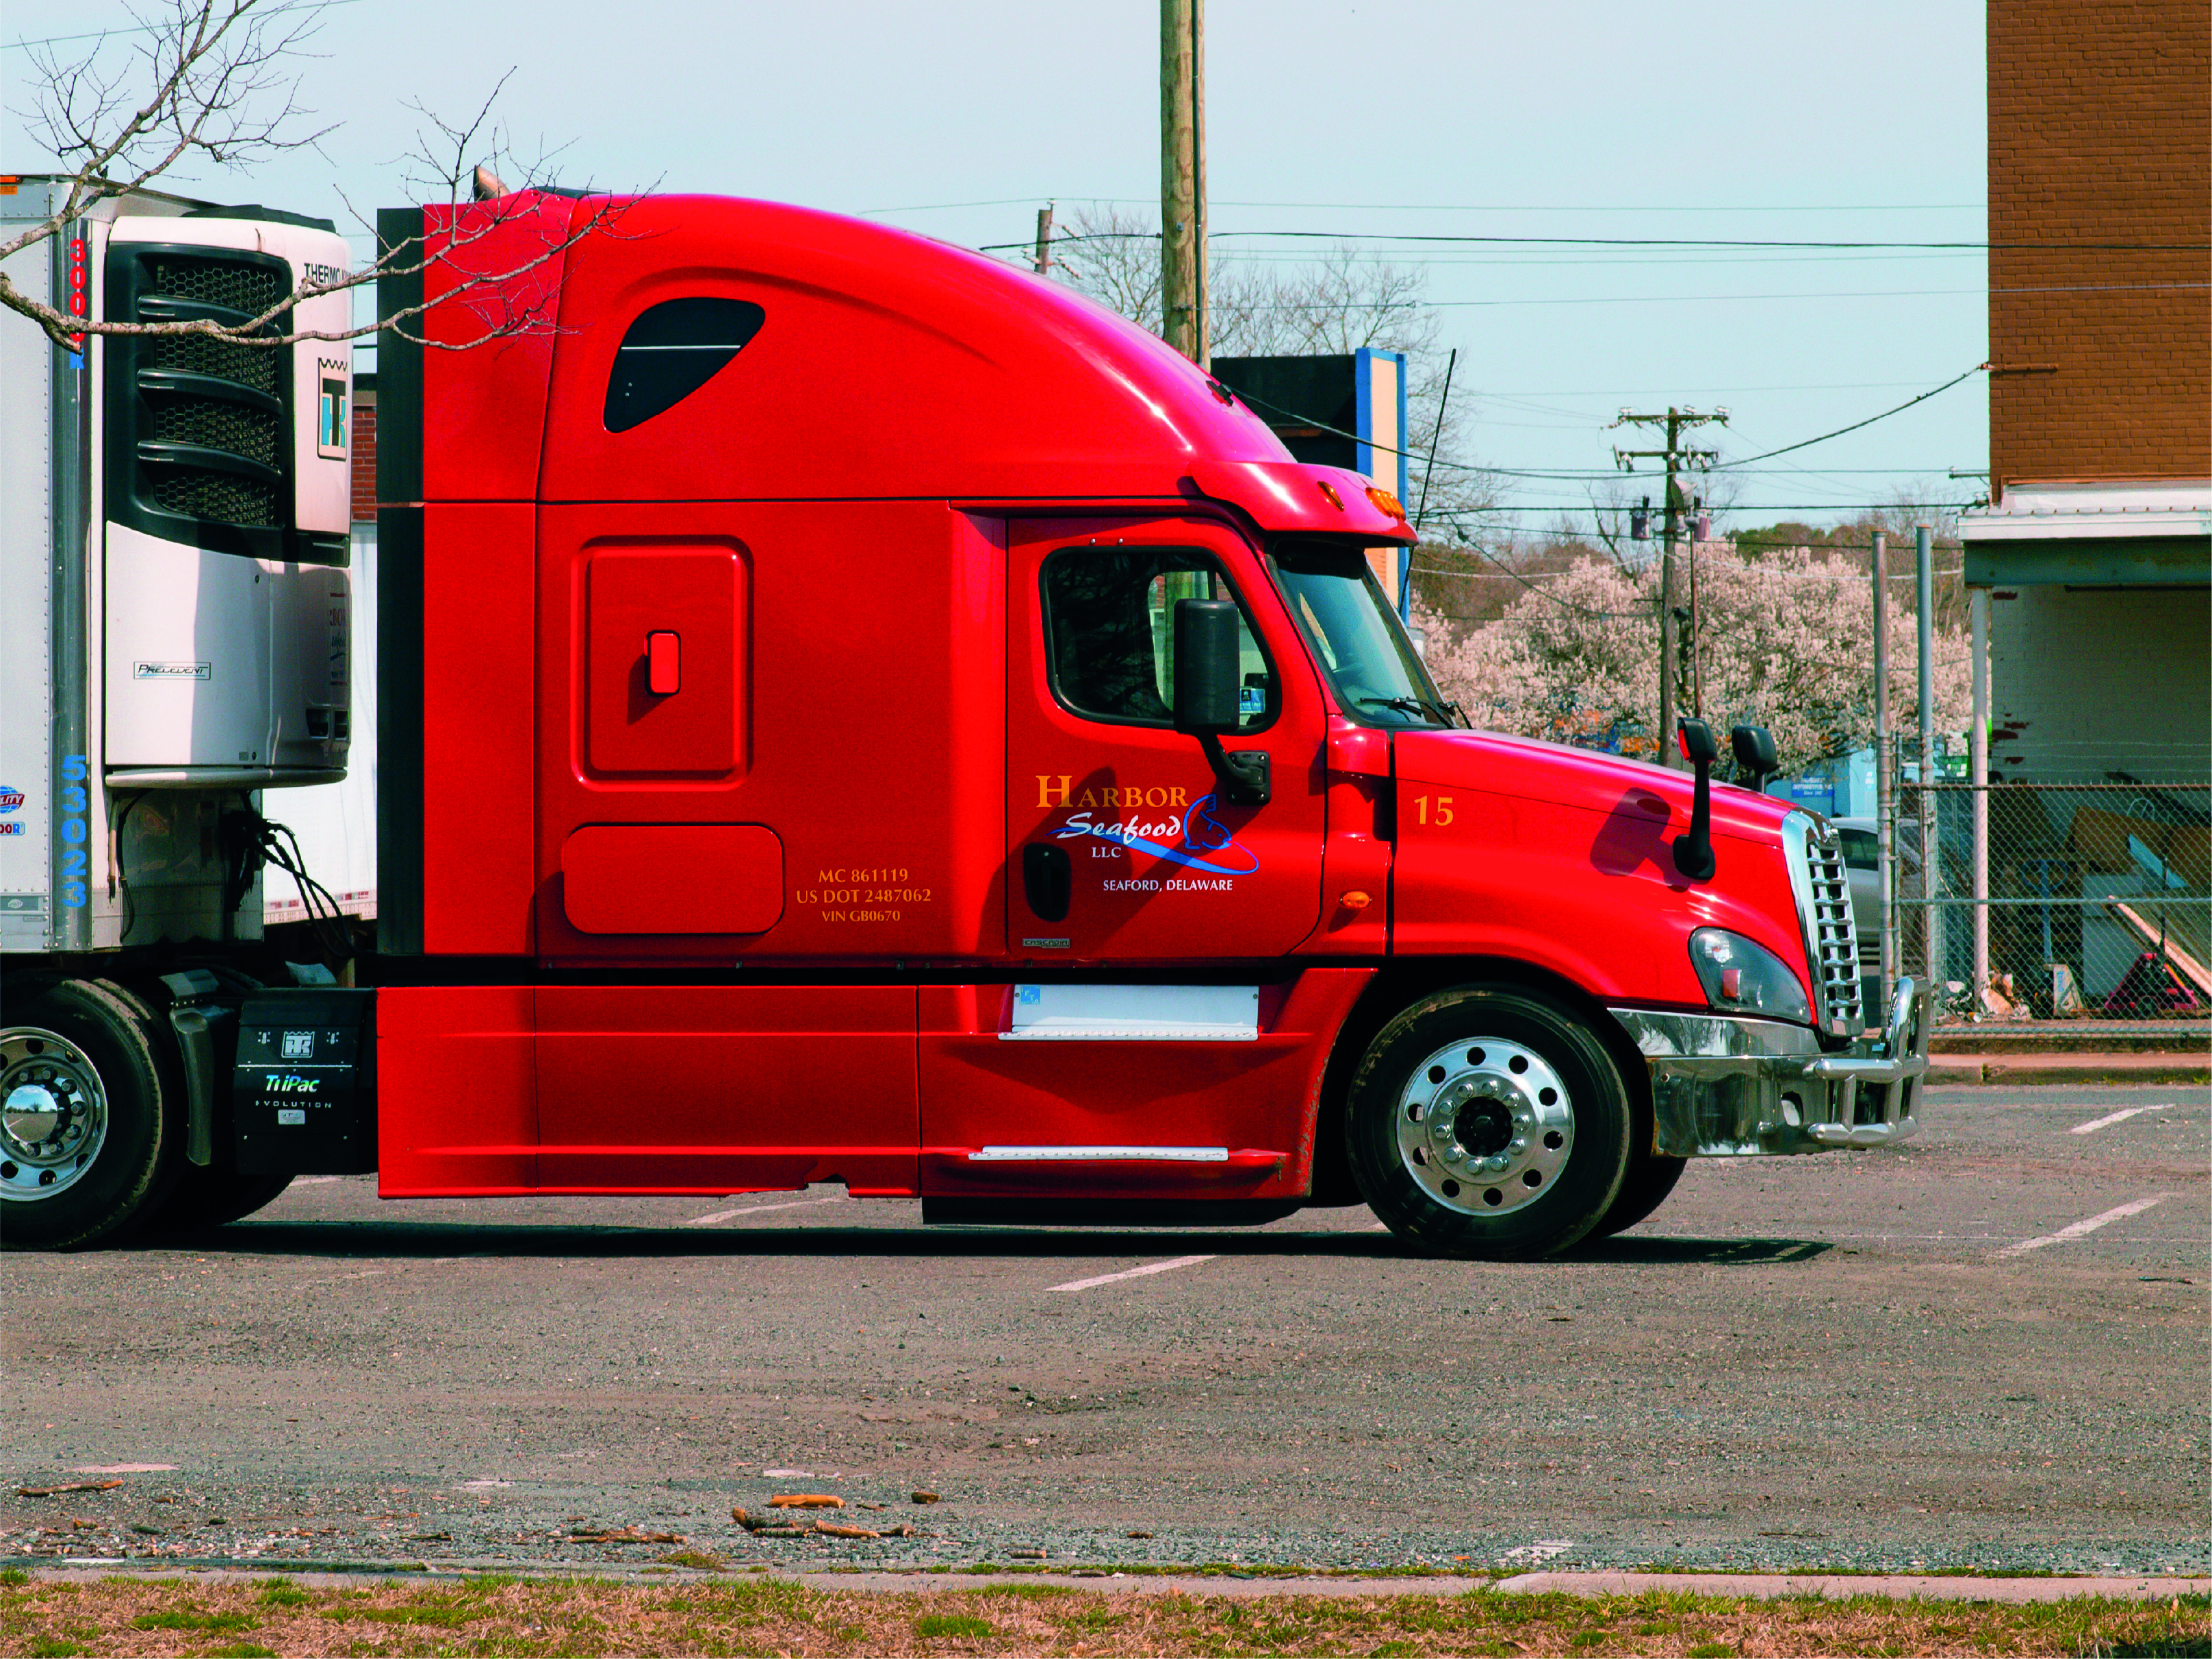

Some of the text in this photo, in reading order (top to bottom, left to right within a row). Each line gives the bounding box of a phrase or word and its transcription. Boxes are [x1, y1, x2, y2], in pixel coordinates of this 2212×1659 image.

[304, 263, 341, 284] THERMO
[1036, 775, 1189, 808] HARBOR
[1414, 795, 1454, 826] 15
[62, 755, 86, 908] 53023
[1057, 812, 1181, 845] Seafood
[1092, 847, 1122, 858] LLC
[819, 868, 908, 883] MC 861119
[1103, 879, 1233, 892] SEAFORD, DELAWARE
[796, 888, 931, 903] US DOT 2487062
[822, 910, 901, 922] VIN GB0670
[266, 1075, 320, 1092] TriPac
[255, 1100, 331, 1108] EVOLUTION
